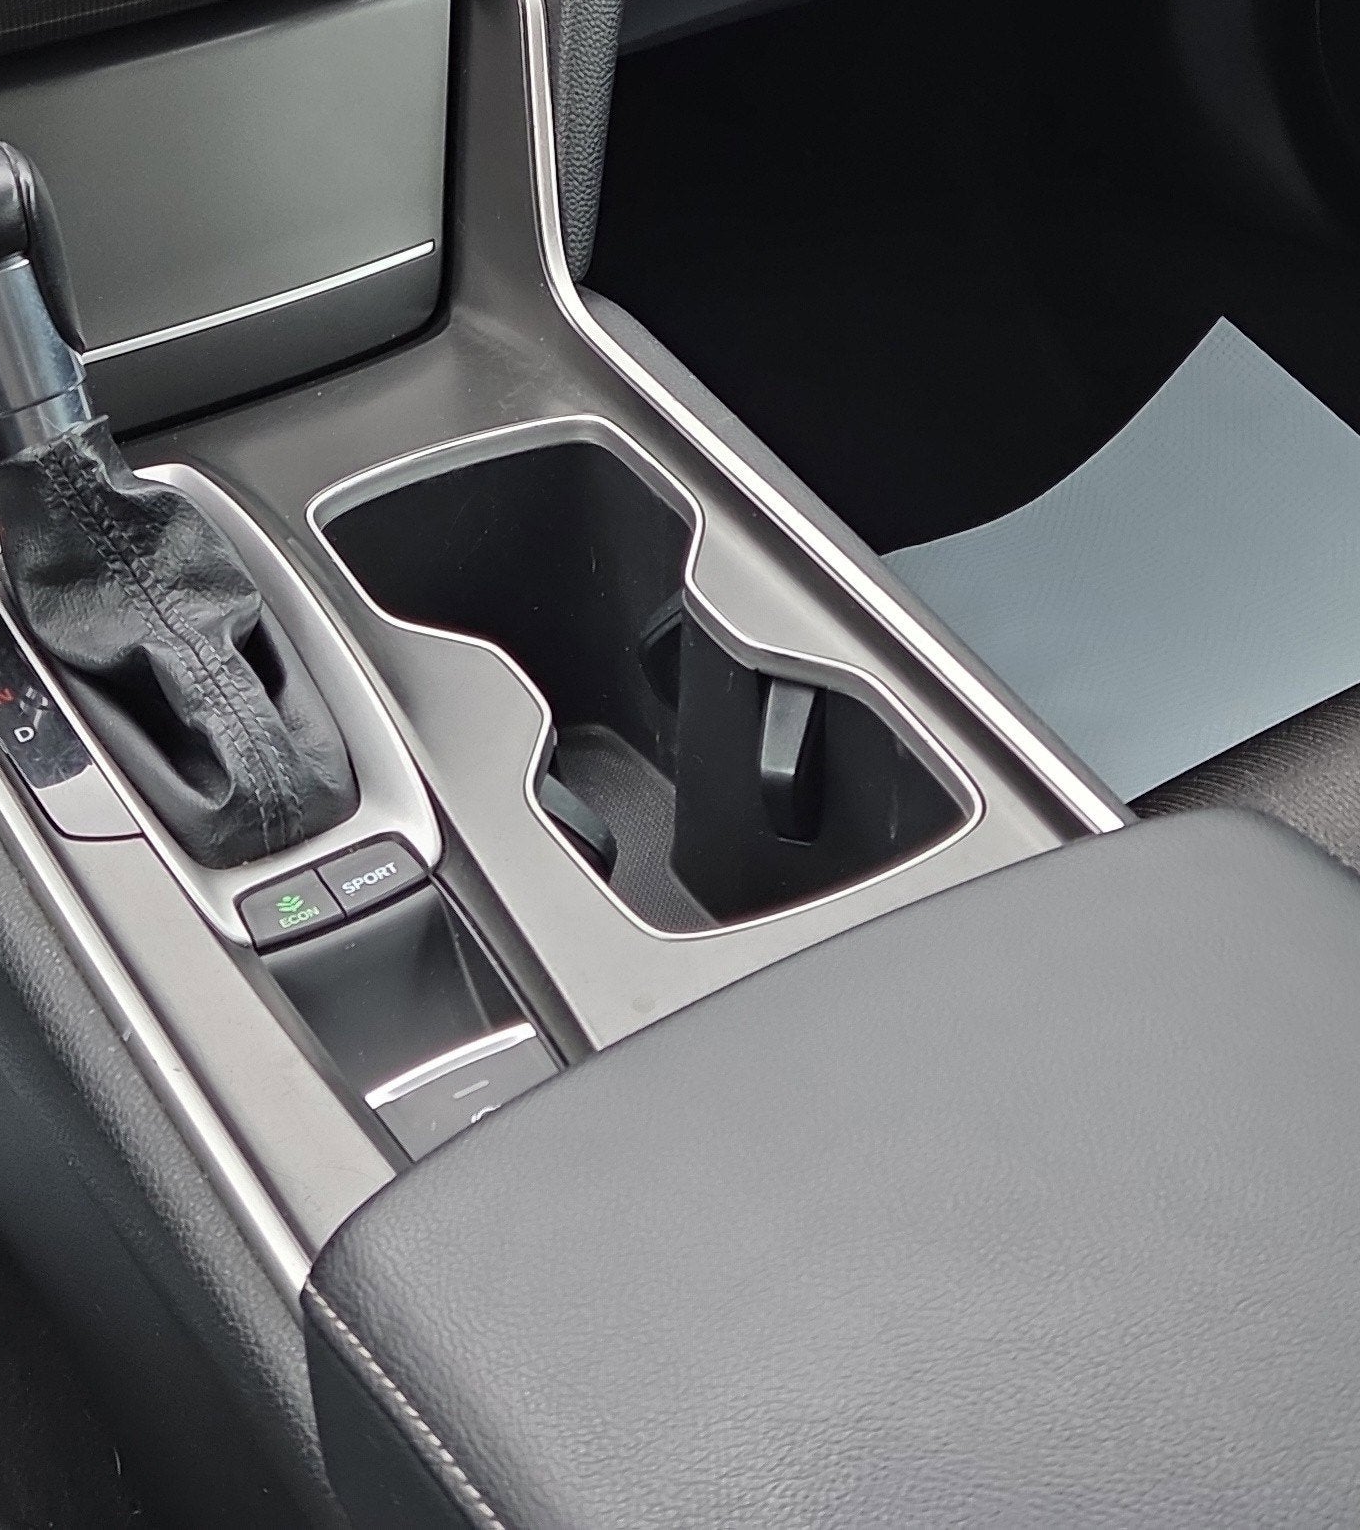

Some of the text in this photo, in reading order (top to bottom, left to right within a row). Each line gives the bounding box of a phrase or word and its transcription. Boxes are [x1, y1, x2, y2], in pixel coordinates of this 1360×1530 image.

[13, 726, 35, 743] D
[341, 861, 399, 896] SPORT
[277, 905, 321, 929] ECON
